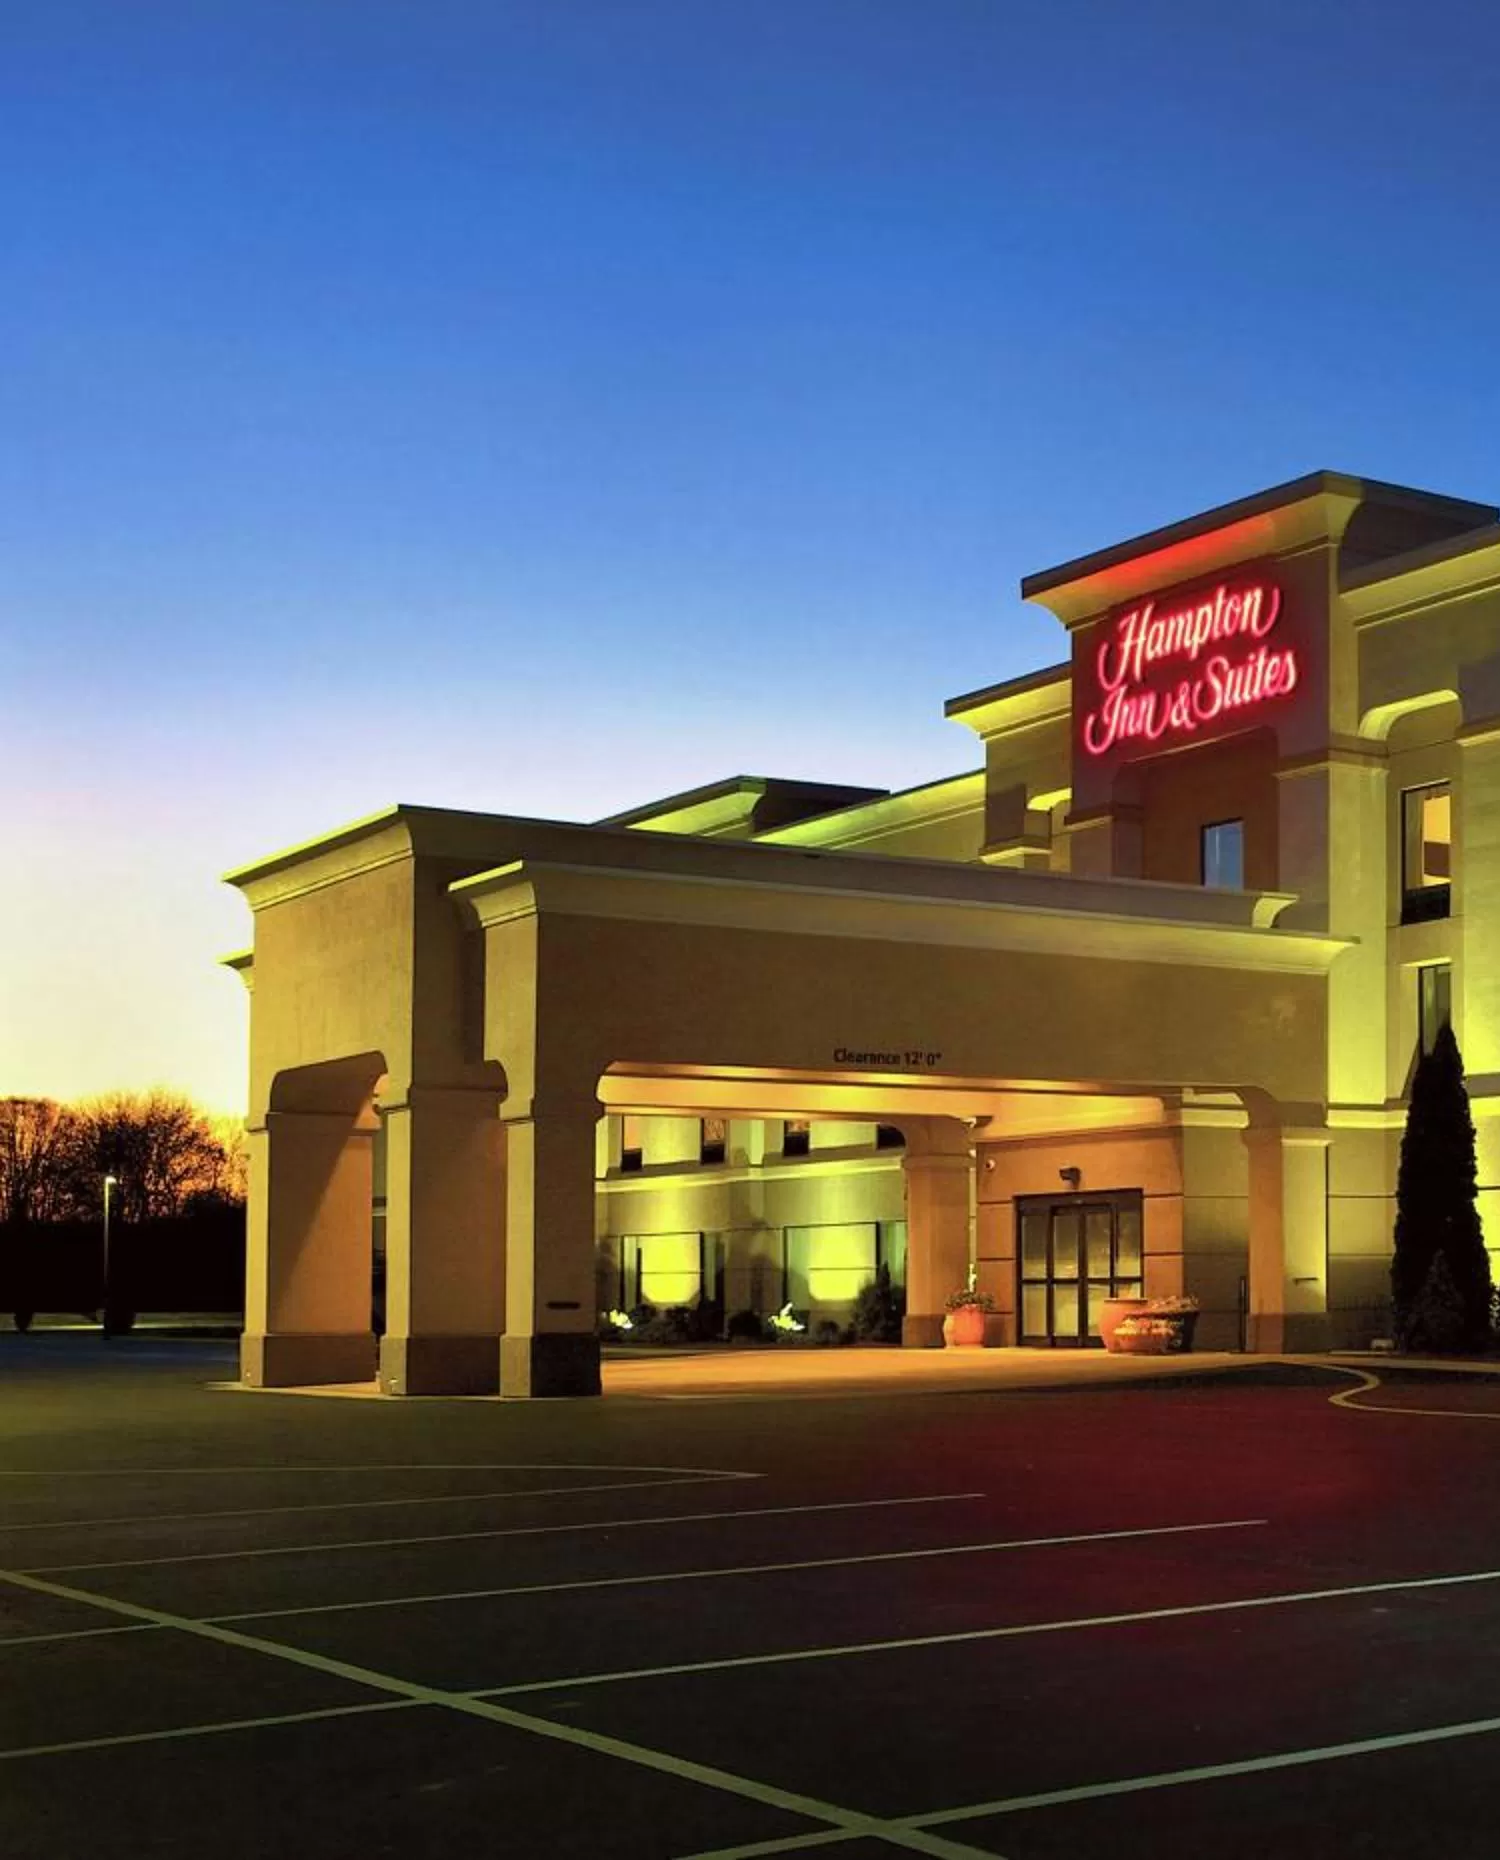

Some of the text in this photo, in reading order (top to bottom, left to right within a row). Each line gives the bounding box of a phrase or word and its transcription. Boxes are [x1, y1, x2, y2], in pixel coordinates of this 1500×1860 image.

[1098, 586, 1281, 690] Hampton
[1085, 646, 1297, 755] Inn & Suites
[833, 1048, 901, 1064] Clearance
